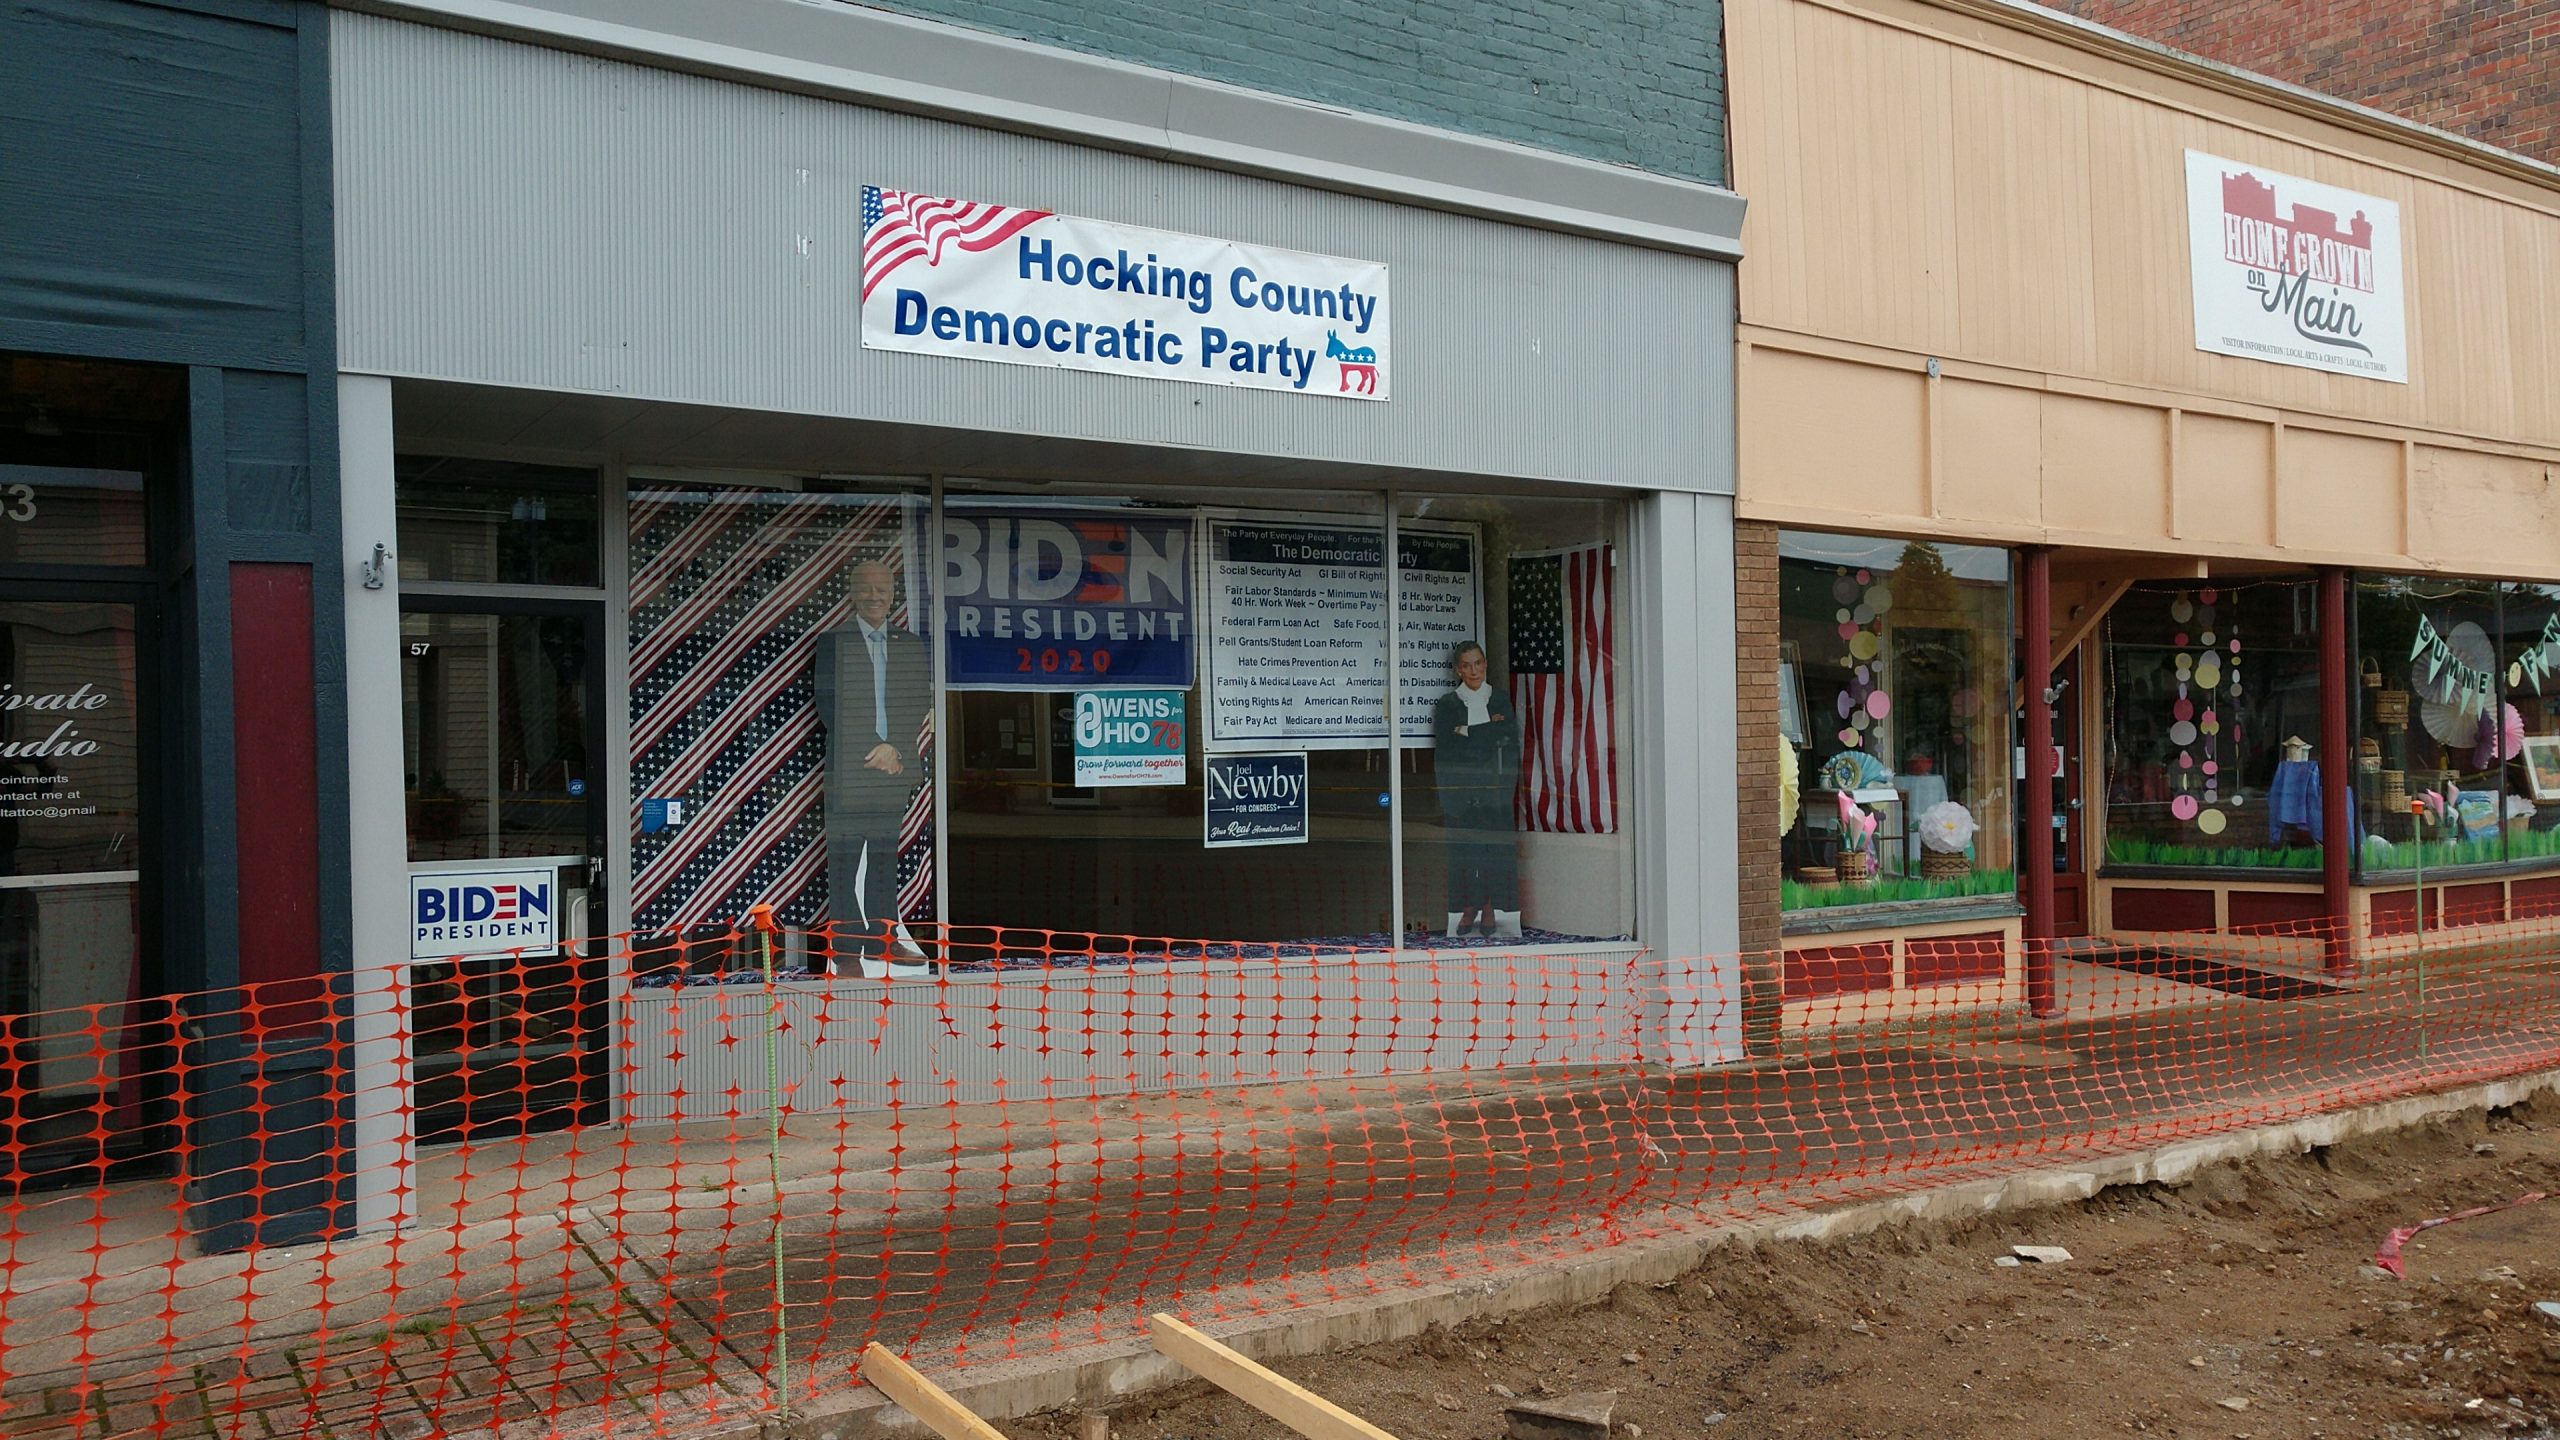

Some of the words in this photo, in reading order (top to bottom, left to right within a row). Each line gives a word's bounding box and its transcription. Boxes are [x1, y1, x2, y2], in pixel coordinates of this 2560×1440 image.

[2225, 212, 2290, 273] HOME
[2294, 231, 2374, 292] GROWN
[1019, 235, 1213, 313] Hocking
[1229, 267, 1377, 334] County
[2247, 269, 2266, 287] on
[2262, 262, 2366, 343] Main
[893, 287, 1183, 365] Democratic
[1201, 326, 1317, 388] Party
[2222, 336, 2245, 348] VISITOR
[2245, 340, 2283, 355] INFORMATION
[2286, 347, 2304, 359] LOCAL
[2305, 350, 2318, 361] ARTS
[2324, 353, 2343, 365] CRAFTS
[2346, 358, 2363, 369] LOCAL
[2364, 360, 2387, 372] AUTHORS
[0, 484, 37, 521] 3
[1222, 528, 1238, 538] The
[1240, 529, 1258, 540] Party
[1270, 531, 1305, 542] Everyday
[1348, 534, 1360, 543] For
[1362, 536, 1373, 544] the
[925, 514, 1185, 605] BIDEN
[1272, 543, 1298, 559] The
[1301, 545, 1380, 562] Democratic
[1220, 565, 1248, 576] Social
[1250, 566, 1287, 579] Security
[1288, 568, 1301, 577] Act
[1319, 569, 1329, 579] GI
[1331, 569, 1346, 579] Bill
[1348, 570, 1357, 579] of
[1404, 572, 1423, 583] Civil
[1425, 574, 1449, 585] Rights
[1452, 575, 1466, 585] Act
[1225, 585, 1243, 595] Fair
[1245, 586, 1270, 596] Labor
[1273, 586, 1317, 597] Standards
[1327, 588, 1367, 600] Minimum
[1402, 591, 1407, 601] 8
[1410, 592, 1421, 601] Hr.
[1424, 592, 1443, 602] Work
[1446, 593, 1461, 604] Day
[1231, 597, 1242, 607] 40
[1245, 598, 1257, 607] Hr.
[1260, 598, 1282, 607] Work
[1285, 598, 1306, 608] Week
[1317, 599, 1358, 610] Overtime
[1360, 601, 1377, 611] Pay
[1410, 602, 1434, 612] Labor
[1436, 603, 1456, 613] Laws
[1222, 616, 1255, 627] Federal
[1258, 617, 1280, 626] Farm
[1283, 618, 1302, 627] Loan
[1304, 618, 1320, 628] Act
[1334, 619, 1353, 628] Safe
[1406, 621, 1421, 631] Air,
[1424, 621, 1447, 631] Water
[1448, 622, 1466, 632] Acts
[410, 643, 430, 656] 57
[1219, 637, 1236, 646] Pell
[1239, 637, 1301, 647] Grants/Student
[1304, 638, 1327, 648] Loan
[1329, 639, 1363, 648] Reform
[1418, 641, 1440, 651] Right
[1442, 641, 1449, 649] to
[1017, 648, 1112, 673] 2020
[1239, 657, 1258, 666] Hate
[1260, 657, 1290, 667] Crimes
[1292, 657, 1339, 667] Prevention
[1341, 658, 1357, 667] Act
[1421, 660, 1453, 669] Schools
[2420, 621, 2489, 694] SUMME
[1217, 676, 1248, 688] Family
[1251, 677, 1257, 686] &
[1259, 677, 1291, 686] Medical
[1292, 677, 1317, 686] Leave
[1320, 677, 1335, 686] Act
[1346, 677, 1385, 687] America
[1411, 678, 1457, 687] Disabilities
[0, 683, 109, 710] ivate
[1219, 697, 1249, 708] Voting
[1252, 697, 1279, 708] Rights
[1281, 697, 1293, 706] Act
[1304, 696, 1349, 706] American
[1407, 696, 1414, 705] &
[1417, 696, 1439, 706] Reco
[1077, 693, 1169, 724] OWENS
[1171, 706, 1183, 716] for
[1223, 716, 1242, 726] Fair
[1245, 716, 1260, 727] Pay
[1263, 716, 1277, 725] Act
[1285, 715, 1322, 725] Medicare
[1325, 715, 1342, 724] and
[1345, 715, 1382, 724] Medicaid
[1399, 715, 1432, 724] ordable
[0, 720, 100, 757] udio
[1077, 713, 1150, 748] OHIO
[1151, 720, 1182, 750] 78
[1077, 759, 1103, 771] Grow
[1103, 758, 1143, 771] forward
[1144, 758, 1184, 771] together
[1235, 764, 1252, 777] Joel
[0, 775, 69, 785] ointments
[1208, 764, 1303, 805] Newby
[42, 792, 62, 800] me
[68, 790, 80, 799] at
[0, 806, 96, 818] ltattoo@gmail
[1235, 804, 1247, 813] FOR
[1248, 803, 1277, 812] CONGRESS
[1210, 827, 1226, 838] Your
[1227, 821, 1252, 836] Real
[418, 884, 548, 924] BIDEN
[418, 921, 548, 941] PRESIDENT
